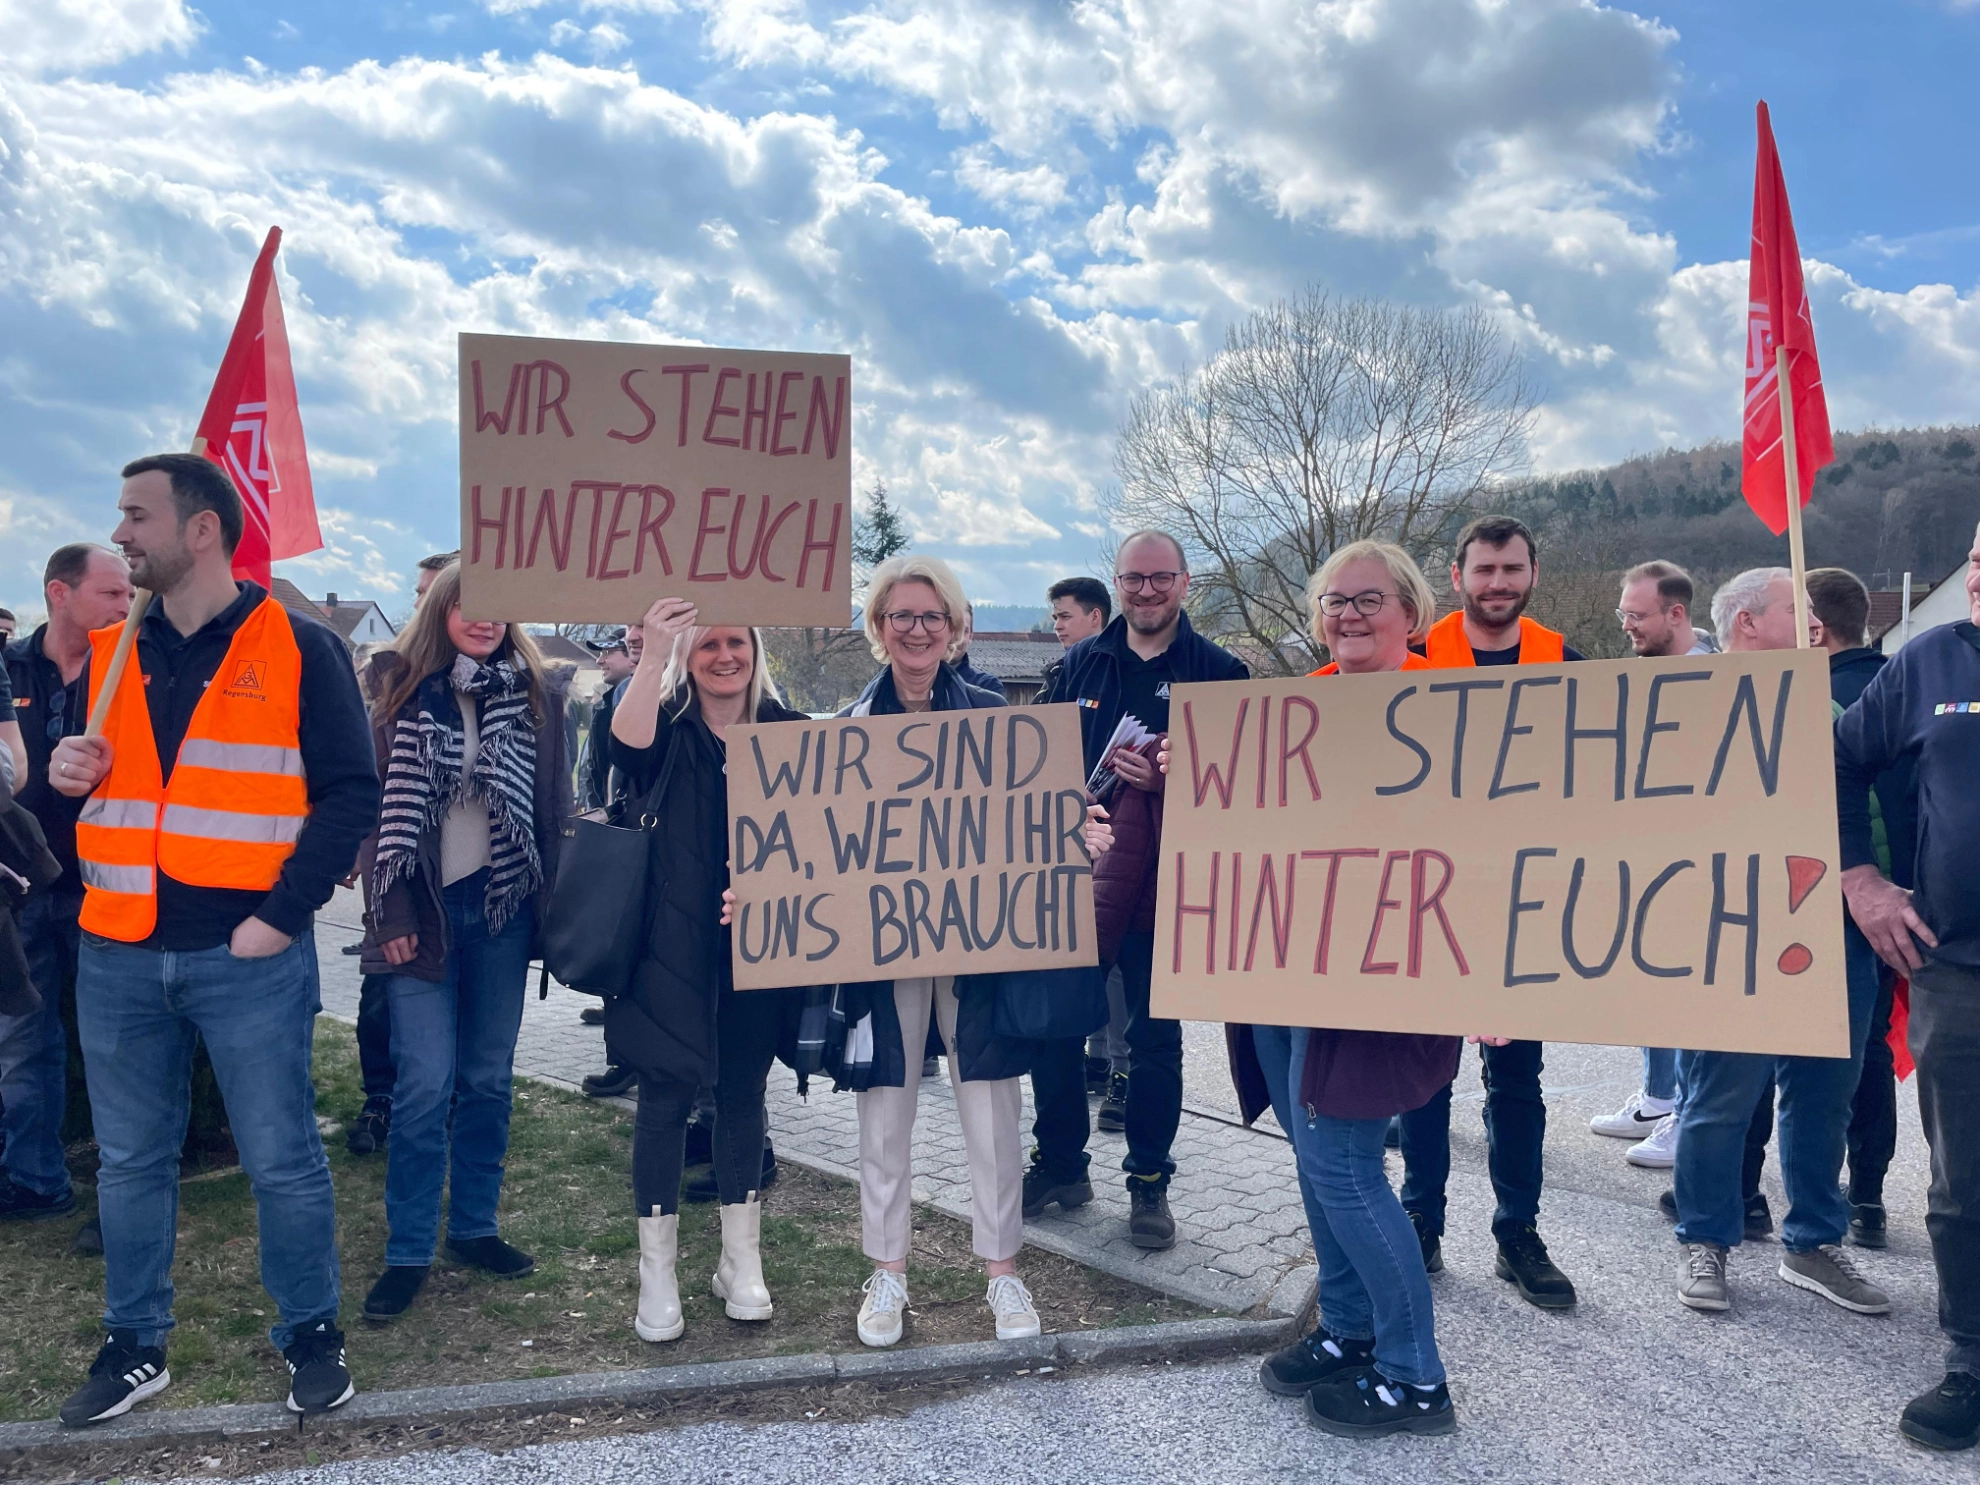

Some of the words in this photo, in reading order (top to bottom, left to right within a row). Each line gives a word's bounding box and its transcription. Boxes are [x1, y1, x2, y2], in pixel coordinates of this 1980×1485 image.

[470, 359, 575, 438] WIR
[606, 364, 846, 460] STEHEN
[470, 480, 676, 581] HINTER
[687, 487, 843, 592] EUCH
[223, 690, 266, 701] Regensburg
[1183, 696, 1322, 809] WIR
[1375, 669, 1793, 801] STEHEN
[750, 725, 873, 800] WIR
[896, 713, 1048, 792] SIND
[735, 809, 814, 880] DA,
[824, 796, 989, 875] WENN
[1006, 789, 1091, 864] IHR
[739, 893, 841, 964] UNS
[868, 865, 1093, 967] BRAUCHT
[1171, 849, 1471, 978] HINTER
[1503, 847, 1828, 995] EUCH!
